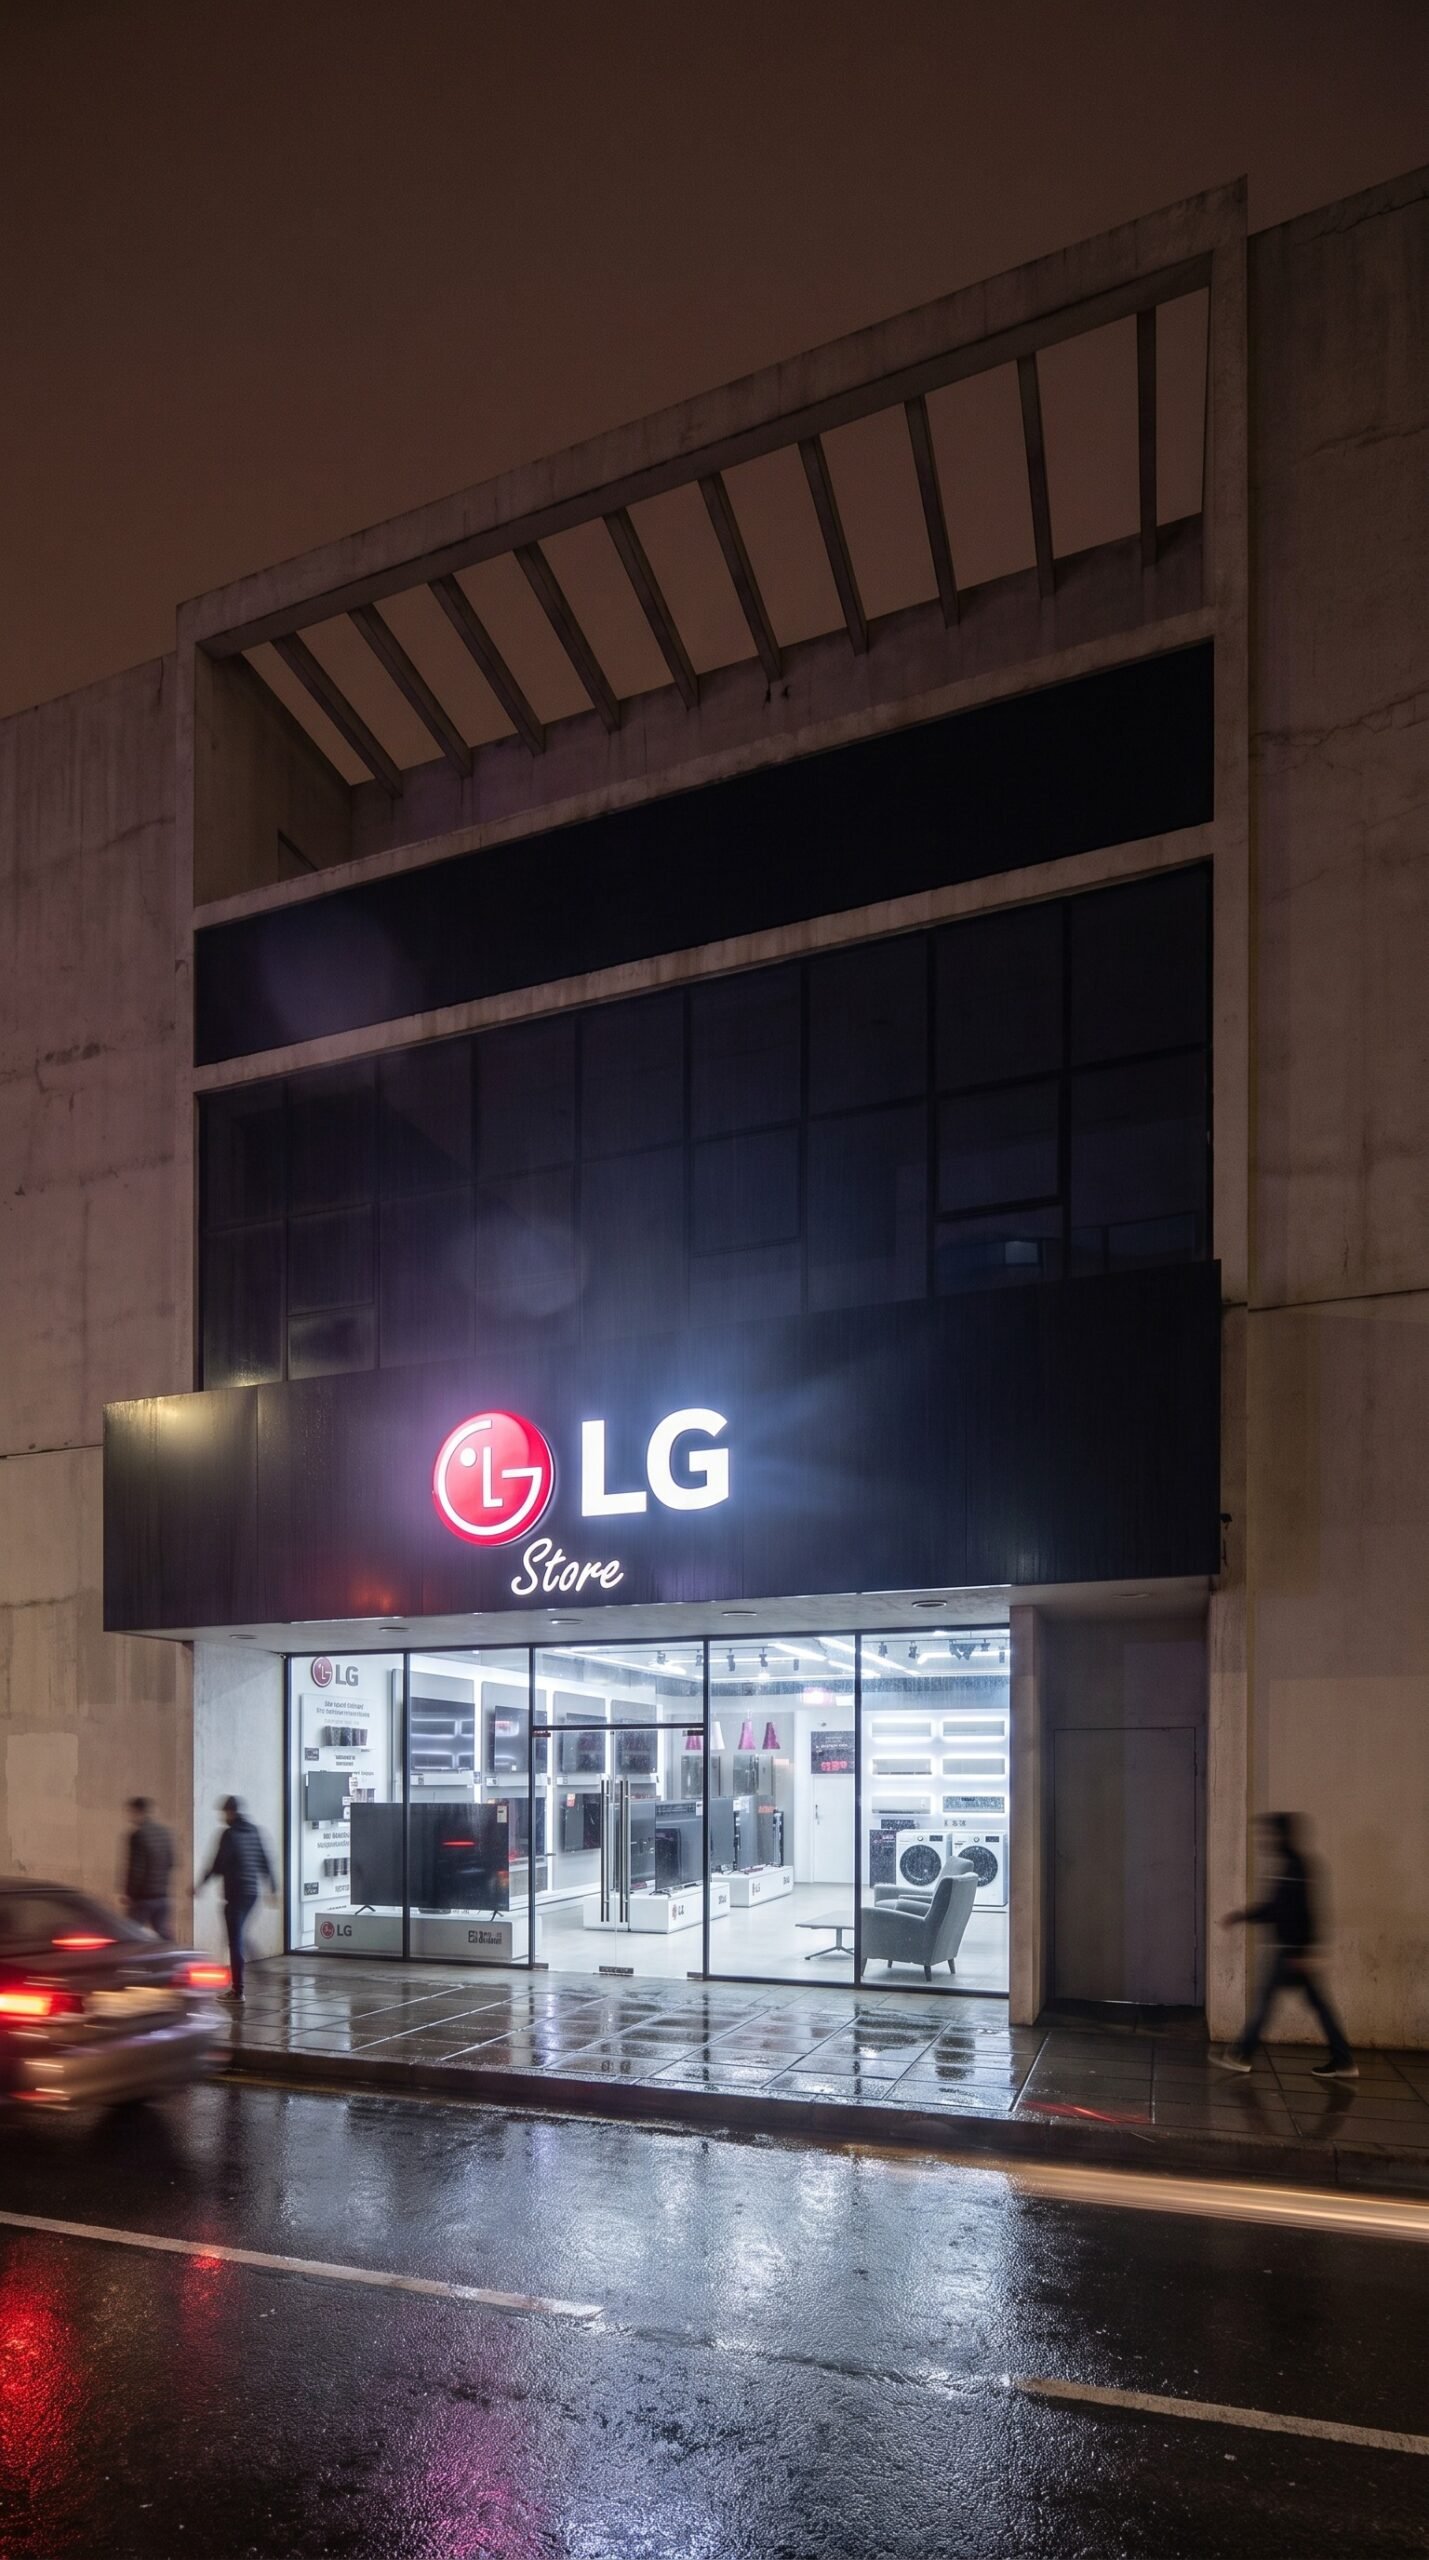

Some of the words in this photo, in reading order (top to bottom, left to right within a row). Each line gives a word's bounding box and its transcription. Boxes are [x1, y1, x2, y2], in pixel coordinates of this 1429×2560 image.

[436, 1416, 546, 1539] LG
[581, 1407, 729, 1517] LG
[510, 1537, 624, 1595] Store
[335, 1664, 359, 1687] LG
[336, 1924, 352, 1937] LG
